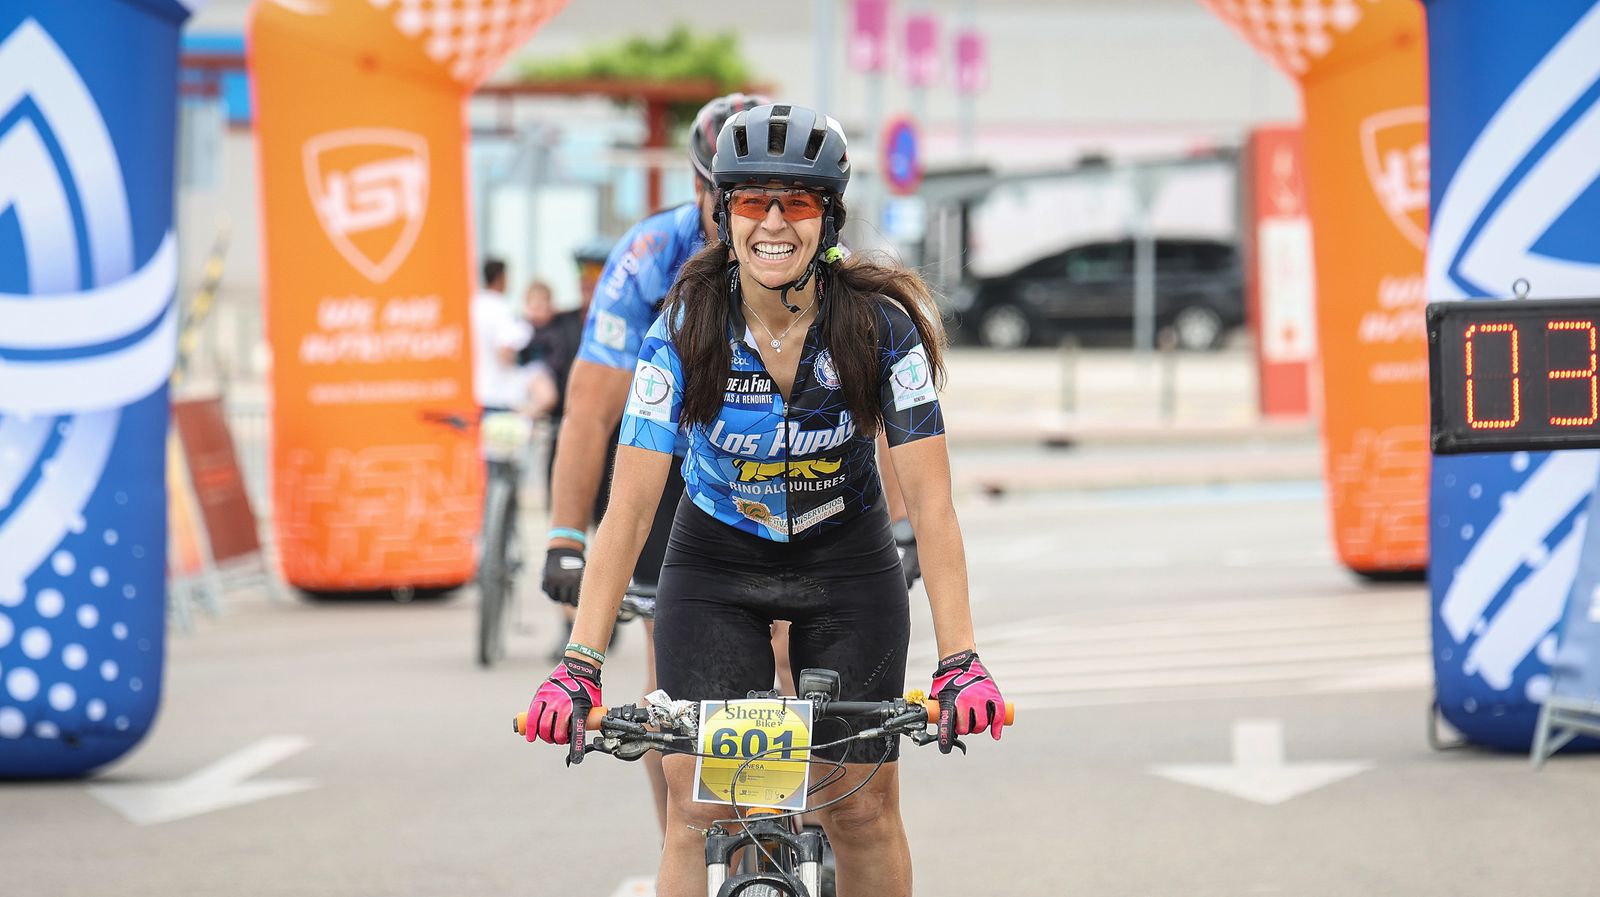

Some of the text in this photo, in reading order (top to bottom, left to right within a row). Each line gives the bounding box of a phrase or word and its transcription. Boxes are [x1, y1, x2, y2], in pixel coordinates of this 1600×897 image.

[742, 394, 773, 404] RENDIRTE
[729, 473, 846, 496] RINO ALQUILERES
[755, 720, 777, 728] Bike
[711, 727, 793, 760] 601
